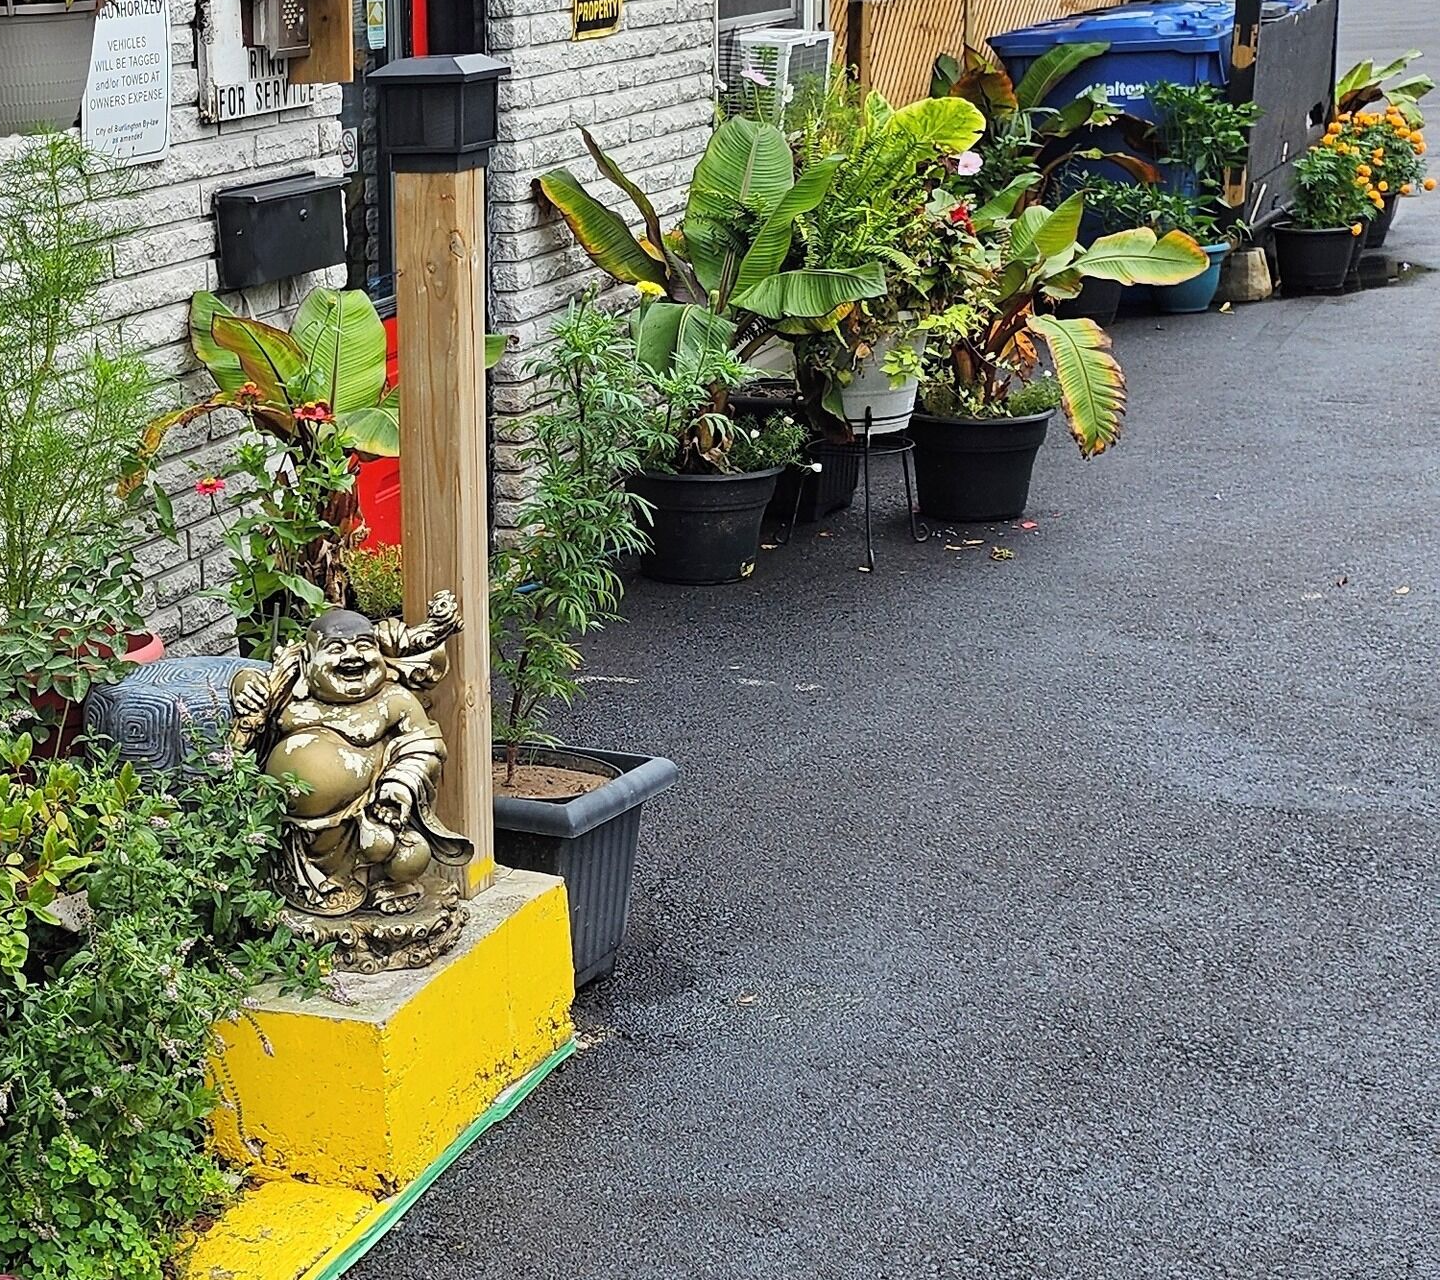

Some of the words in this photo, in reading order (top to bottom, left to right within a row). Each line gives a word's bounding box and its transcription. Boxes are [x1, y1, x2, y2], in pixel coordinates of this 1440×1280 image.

[98, 0, 163, 20] AUTHORIZED
[107, 36, 147, 52] VEHICLES
[94, 60, 114, 72] WILL
[116, 57, 126, 69] BE
[128, 52, 160, 67] TAGGED
[95, 76, 120, 91] and/or
[121, 72, 150, 87] TOWED
[151, 70, 160, 82] AT
[1095, 81, 1145, 97] alton
[90, 94, 126, 111] OWNERS
[128, 88, 163, 104] EXPENSE
[219, 86, 246, 119] FOR
[255, 78, 315, 111] SERVICE
[95, 127, 106, 137] City
[107, 126, 113, 134] of
[114, 122, 142, 133] Burlington
[120, 132, 143, 142] amended
